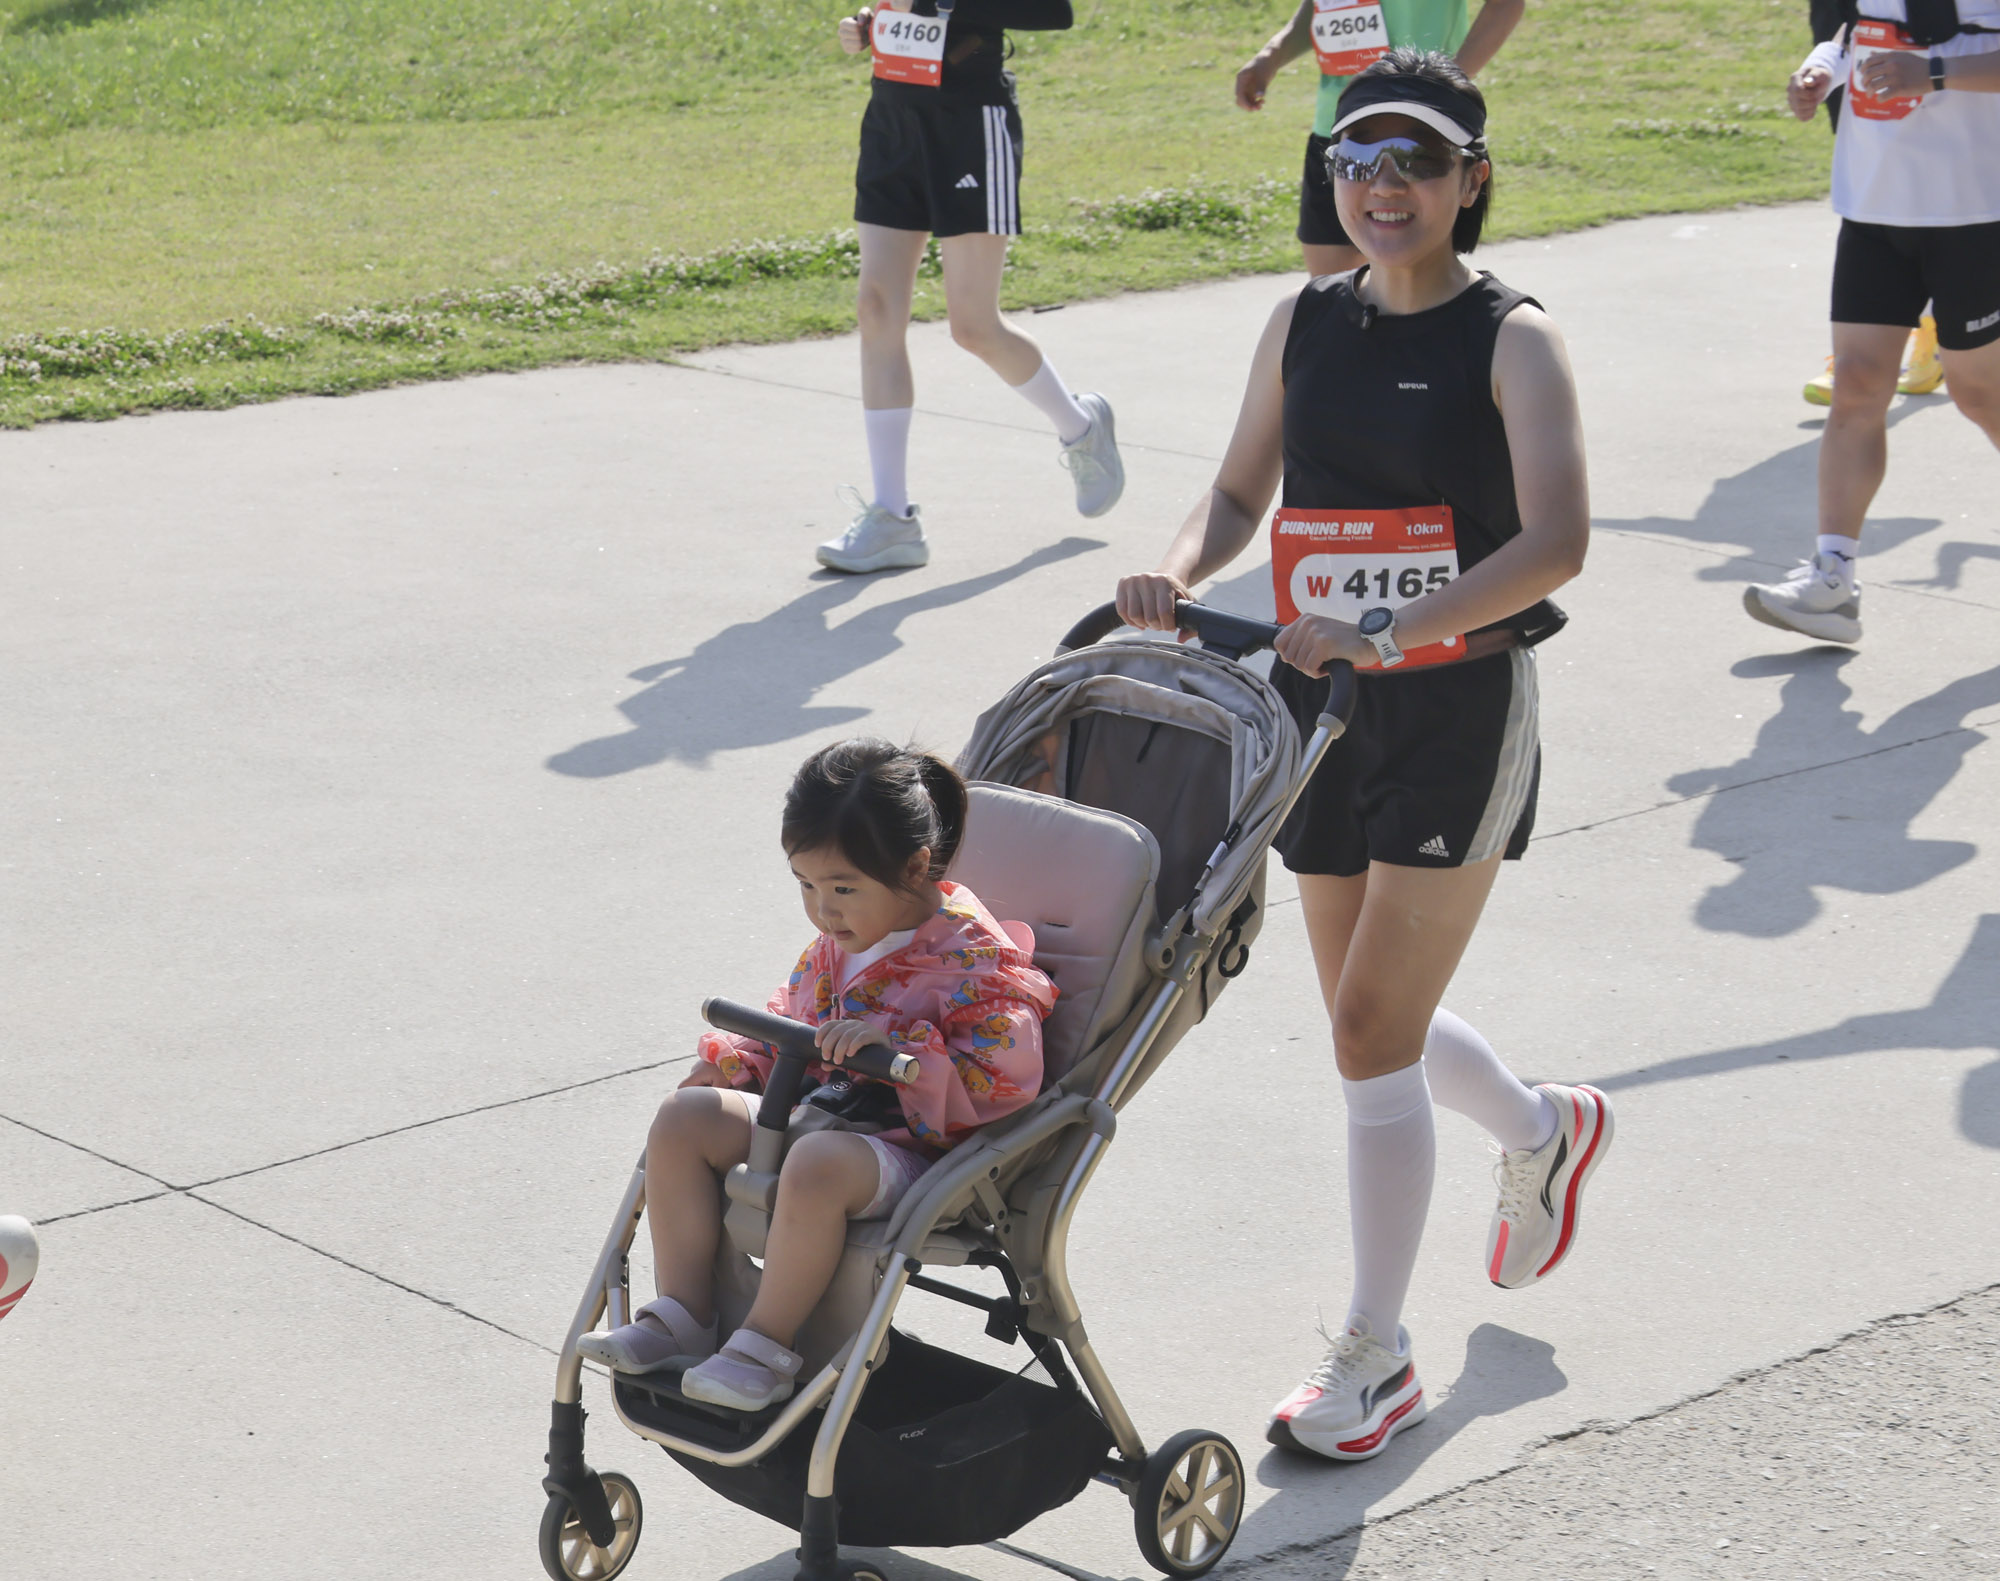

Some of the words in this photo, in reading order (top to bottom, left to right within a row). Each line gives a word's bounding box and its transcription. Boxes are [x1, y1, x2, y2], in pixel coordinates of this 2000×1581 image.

[878, 23, 887, 35] W
[890, 21, 942, 43] 4160
[1316, 26, 1325, 36] M
[1330, 14, 1379, 37] 2604
[1279, 520, 1339, 535] BURNING
[1342, 521, 1375, 535] RUN
[1405, 523, 1443, 536] 10km
[1306, 576, 1333, 598] W
[1343, 565, 1451, 599] 4165
[1419, 846, 1449, 858] adidas
